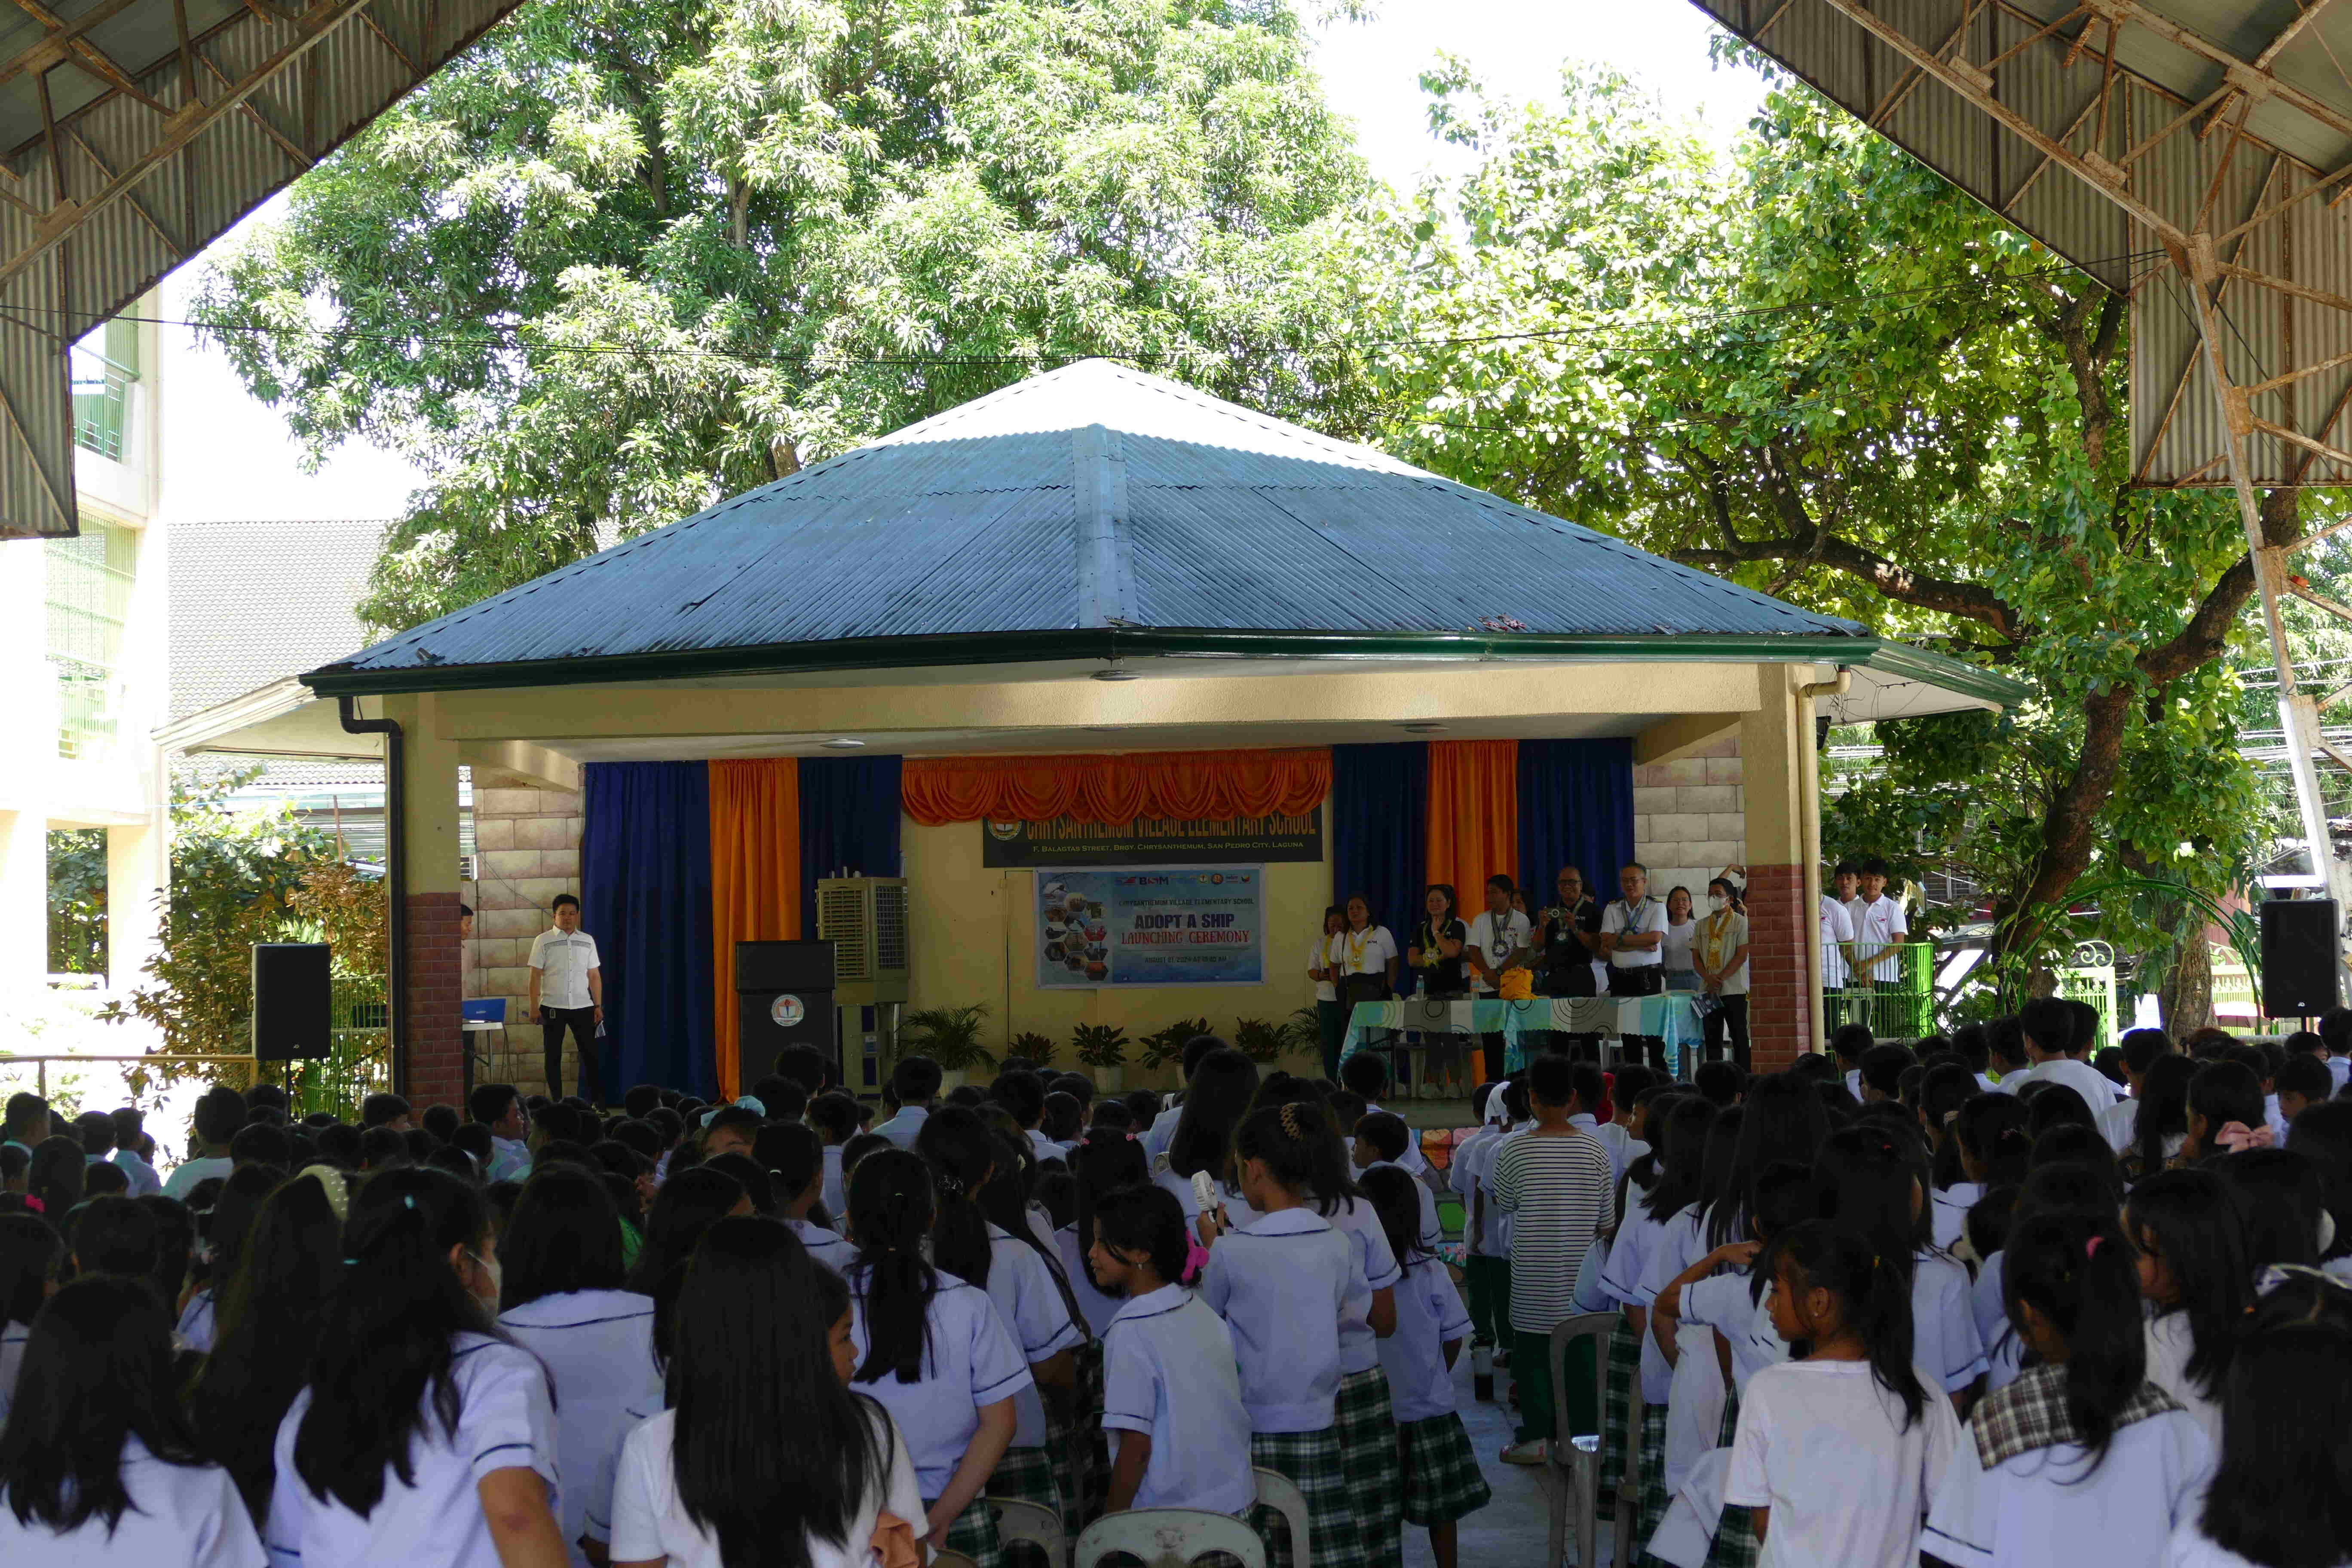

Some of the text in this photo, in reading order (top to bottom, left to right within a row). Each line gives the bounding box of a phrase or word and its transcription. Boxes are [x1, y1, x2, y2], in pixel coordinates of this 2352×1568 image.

[1135, 913, 1235, 929] ADOPT A SHIP
[1121, 930, 1250, 945] LAUNCHING CEREMONY
